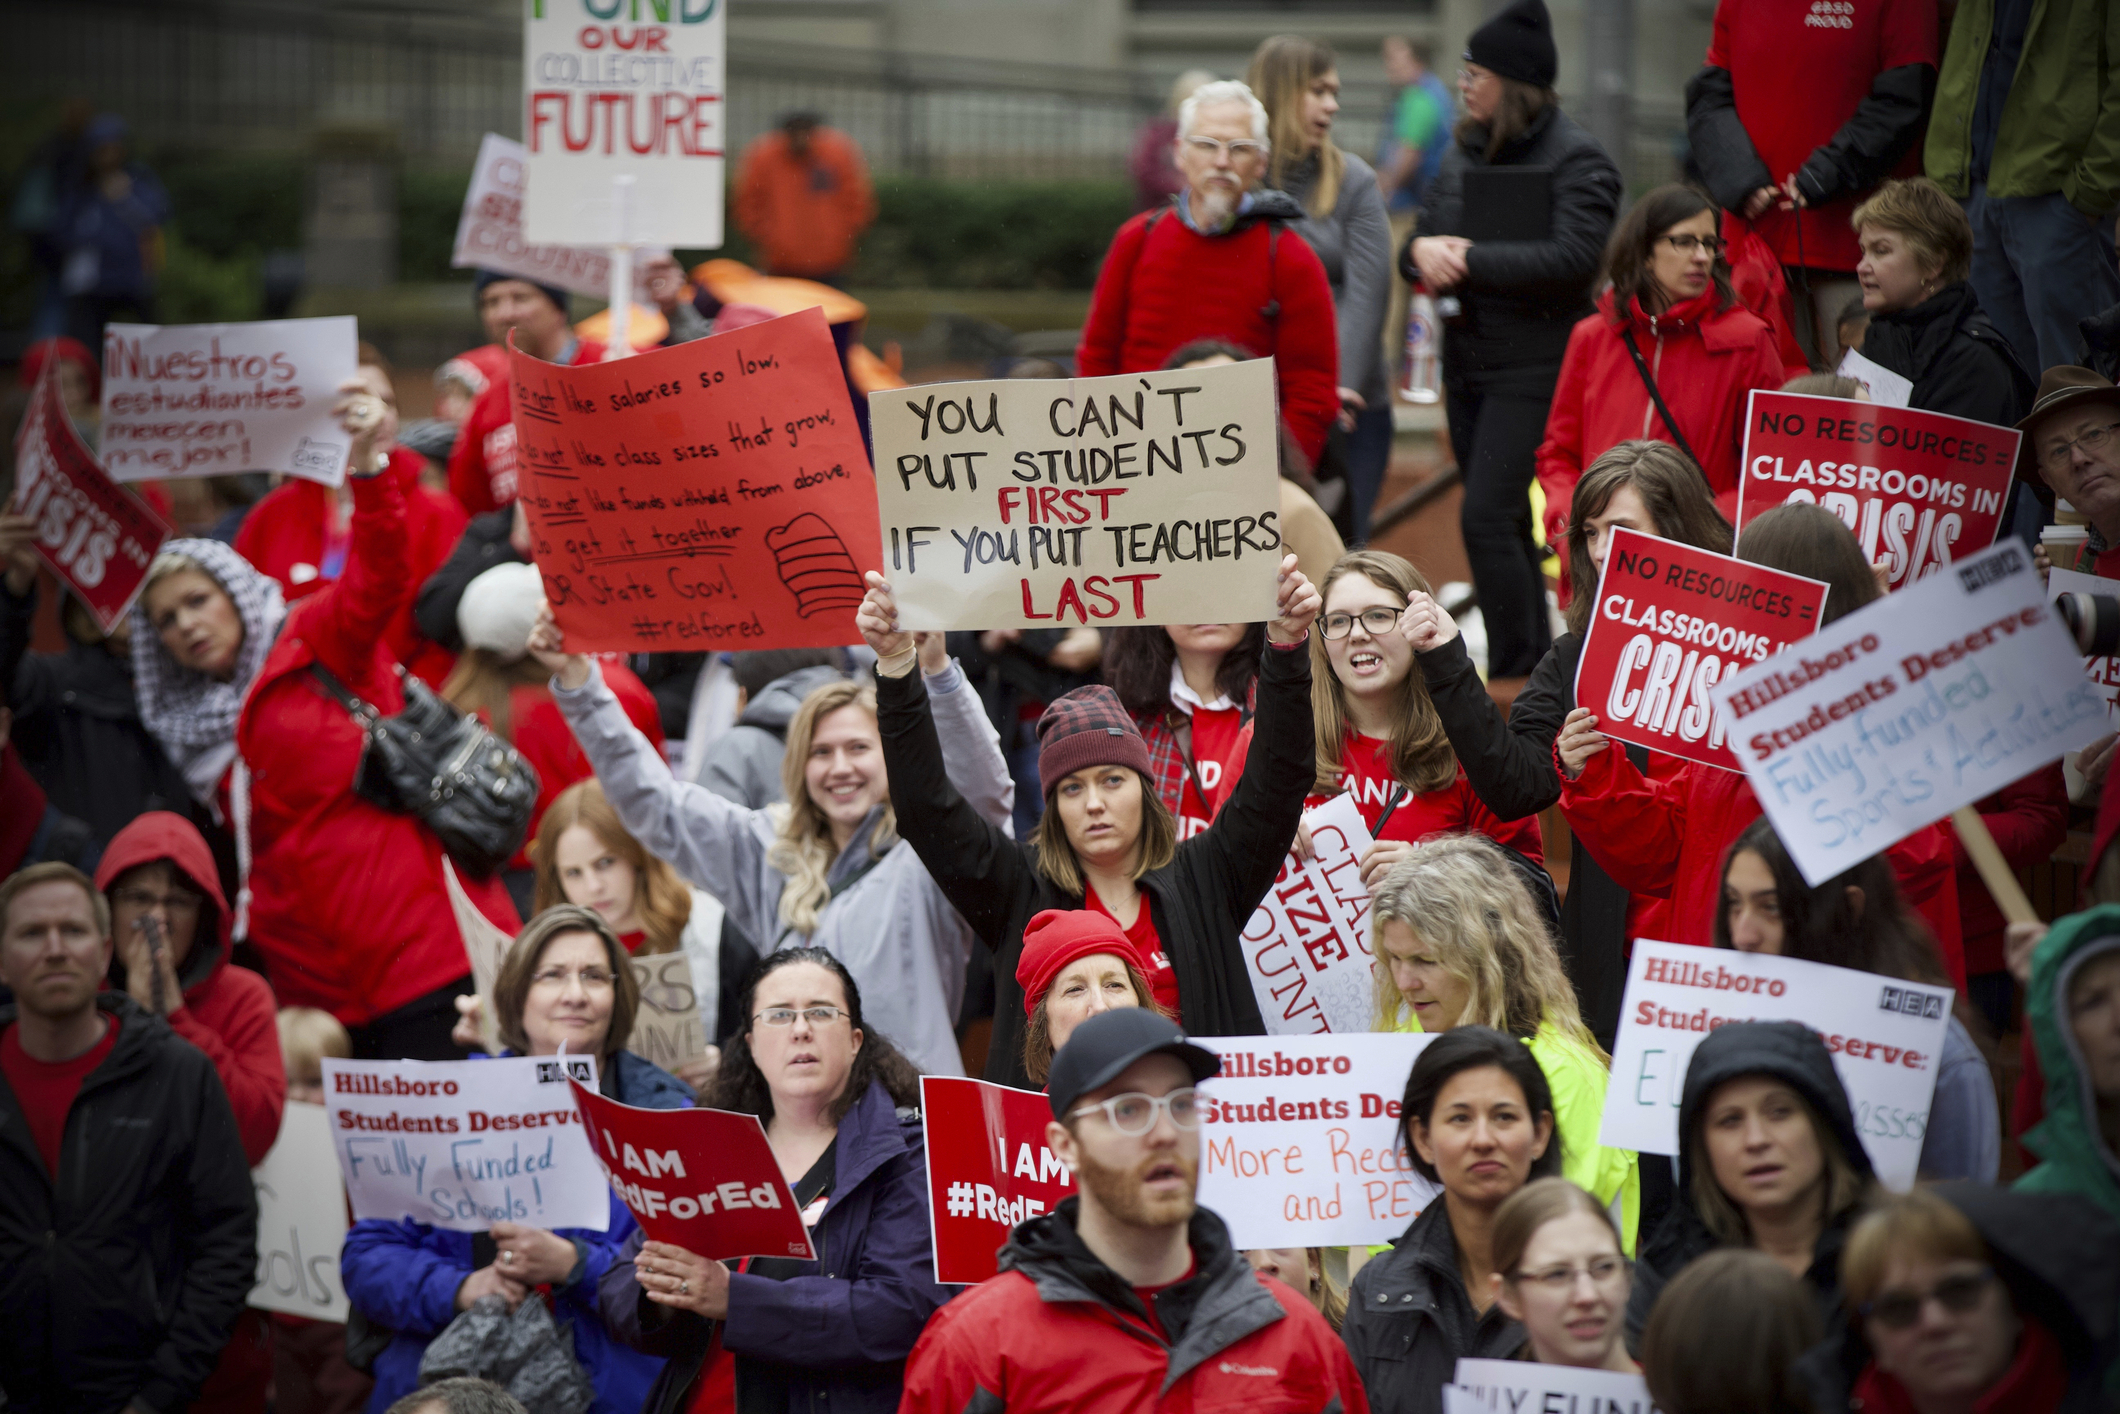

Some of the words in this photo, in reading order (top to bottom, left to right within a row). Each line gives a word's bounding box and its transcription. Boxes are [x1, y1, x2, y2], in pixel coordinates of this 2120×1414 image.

[578, 26, 669, 51] OUR
[535, 53, 716, 90] COLLECTIVE
[530, 90, 724, 156] FUTURE
[109, 385, 306, 414] estudiantes
[557, 379, 597, 414] like
[609, 379, 681, 412] salaries
[699, 371, 724, 388] so
[736, 350, 779, 376] low,
[907, 393, 1005, 440] YOU
[1050, 378, 1202, 438] CAN'T
[105, 440, 251, 473] mejor!
[569, 439, 606, 466] like
[614, 442, 662, 467] class
[672, 443, 720, 463] sizes
[728, 416, 773, 452] that
[785, 409, 835, 448] grow,
[897, 452, 988, 491] PUT
[1012, 423, 1247, 485] STUDENTS
[1760, 411, 1805, 437] NO
[1817, 416, 1988, 466] RESOURCES
[585, 486, 617, 511] like
[737, 479, 784, 501] from
[794, 466, 850, 492] above,
[998, 486, 1129, 524] FIRST
[1751, 455, 1967, 508] CLASSROOMS
[1971, 488, 2000, 516] IN
[564, 526, 603, 573] get
[618, 526, 637, 554] it
[653, 518, 743, 557] together
[891, 525, 941, 573] IF
[951, 525, 1020, 573] YOU
[1029, 525, 1093, 570] PUT
[1103, 511, 1281, 568] TEACHERS
[1784, 488, 1962, 588] RISIS
[542, 573, 587, 606] OR
[588, 571, 657, 605] State
[668, 563, 738, 600] Gov!
[1020, 573, 1162, 625] LAST
[1617, 550, 1658, 580] NO
[1666, 564, 1791, 619] RESOURCES
[631, 611, 764, 641] #redfored
[1603, 594, 1770, 662] CLASSROOMS
[1728, 632, 1880, 720] Hillsboro
[1749, 672, 1899, 761] Students
[1644, 957, 1786, 997] Hillsboro
[1879, 985, 1943, 1019] HEA
[334, 1072, 459, 1096] Hillsboro
[338, 1110, 459, 1134] Students
[345, 1137, 427, 1196] Fully
[450, 1135, 555, 1181] Funded
[602, 1127, 618, 1160] I
[623, 1142, 687, 1179] AM
[999, 1136, 1007, 1173] I
[1014, 1142, 1070, 1187] AM
[1208, 1136, 1304, 1178] More
[1326, 1127, 1414, 1176] Rece
[430, 1176, 544, 1222] Schools!
[947, 1181, 1055, 1229] #RedF
[1284, 1182, 1342, 1221] and
